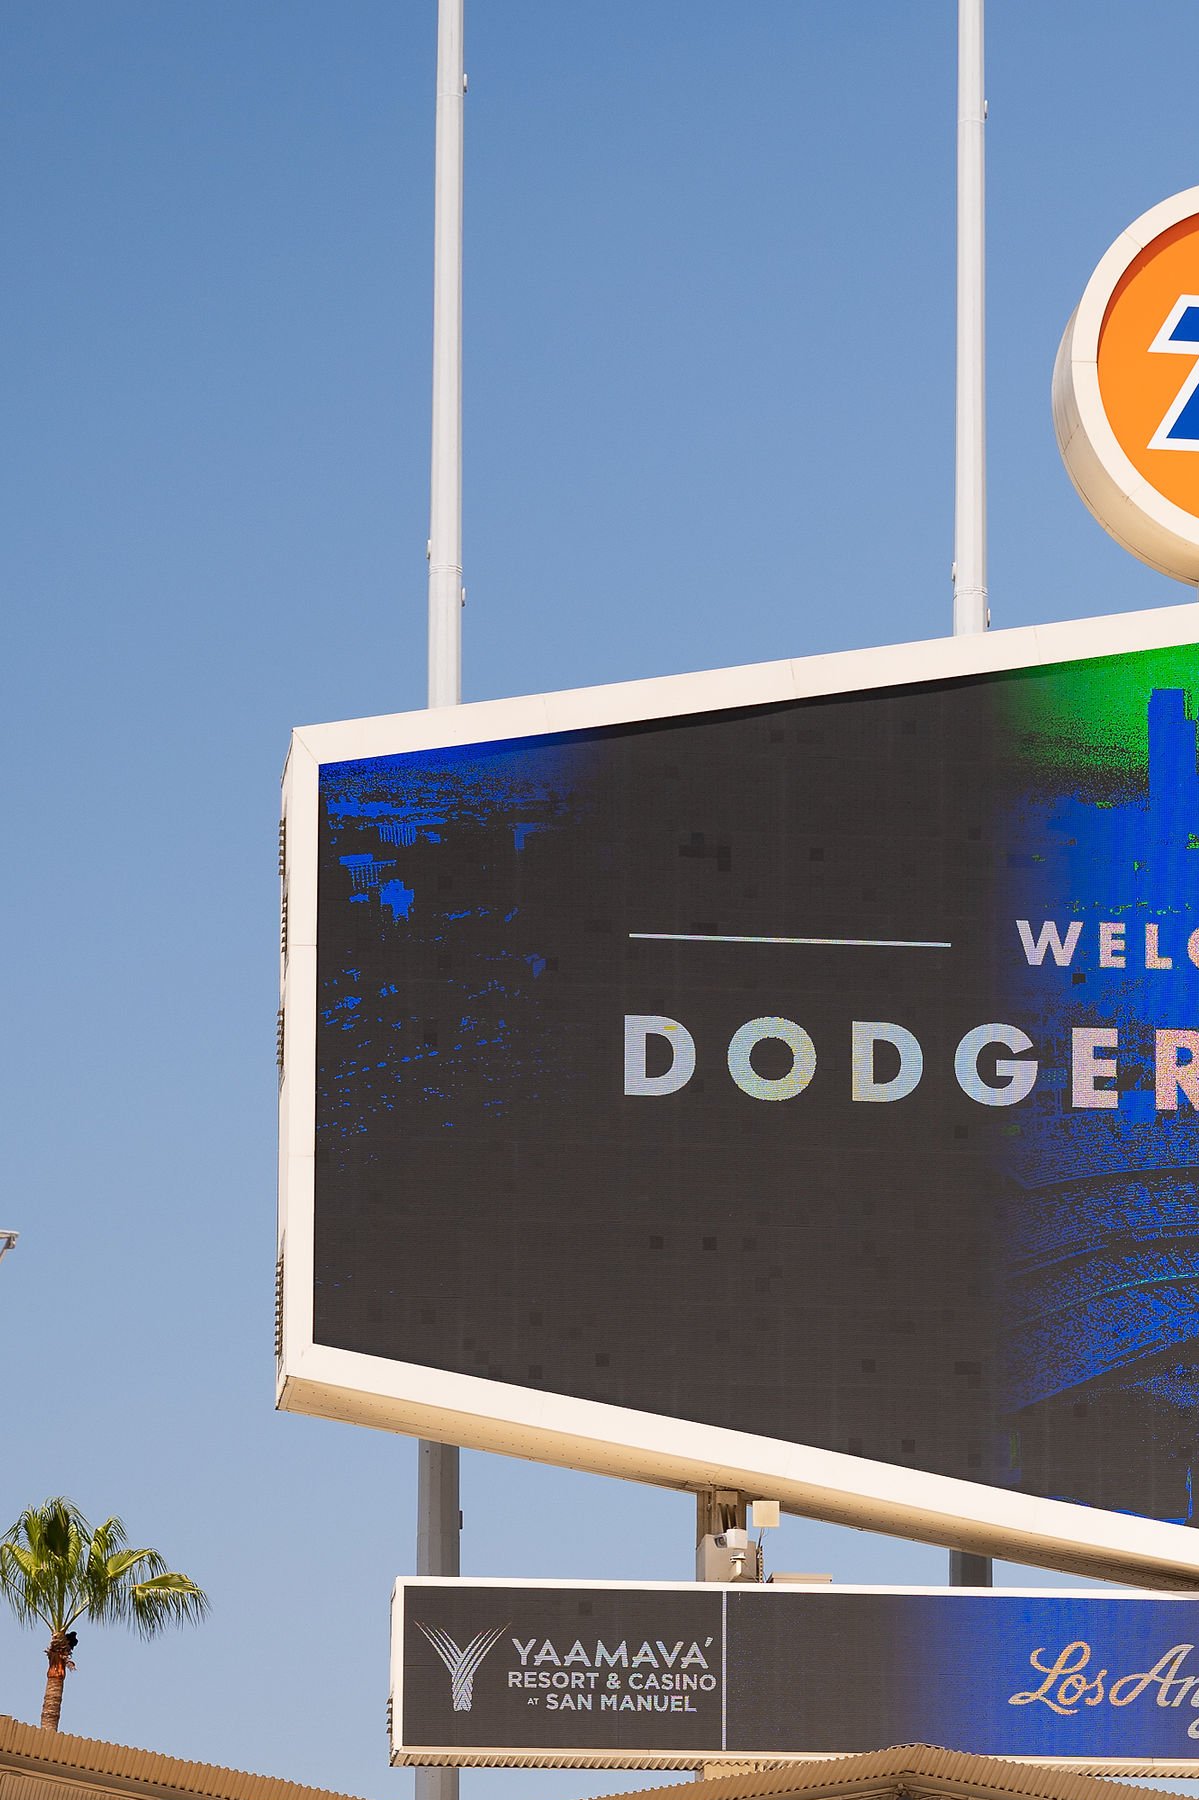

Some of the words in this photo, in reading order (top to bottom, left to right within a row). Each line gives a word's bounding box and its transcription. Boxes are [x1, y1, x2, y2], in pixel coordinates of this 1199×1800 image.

[509, 1671, 600, 1689] RESORT
[607, 1672, 622, 1690] &
[629, 1672, 717, 1691] CASINO
[1008, 1641, 1105, 1717] Los
[527, 1697, 540, 1706] AT
[546, 1693, 593, 1711] SAN
[601, 1694, 698, 1713] MANUEL
